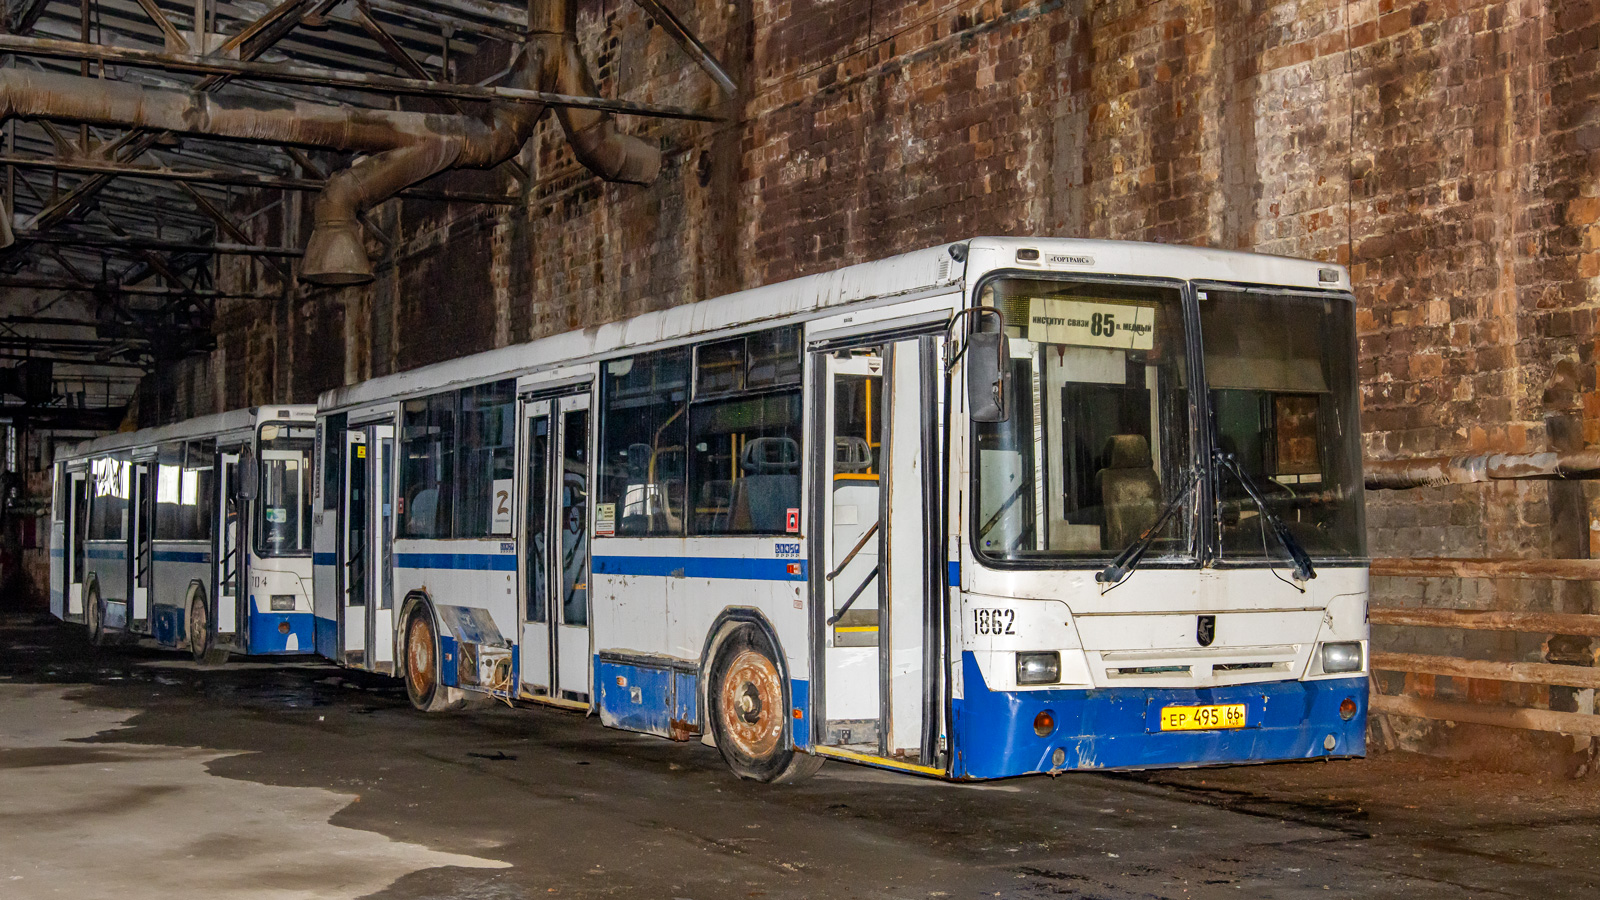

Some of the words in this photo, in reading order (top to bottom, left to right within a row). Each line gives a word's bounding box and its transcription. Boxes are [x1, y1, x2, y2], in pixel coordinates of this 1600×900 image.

[1032, 316, 1066, 326] ИНСТИТУТ
[1067, 318, 1090, 328] СВЯЗИ
[1090, 312, 1115, 338] 85
[496, 489, 509, 516] 2
[973, 608, 1016, 636] 1862
[1170, 713, 1186, 727] ЕР
[1193, 709, 1219, 726] 495
[1226, 707, 1240, 720] 66
